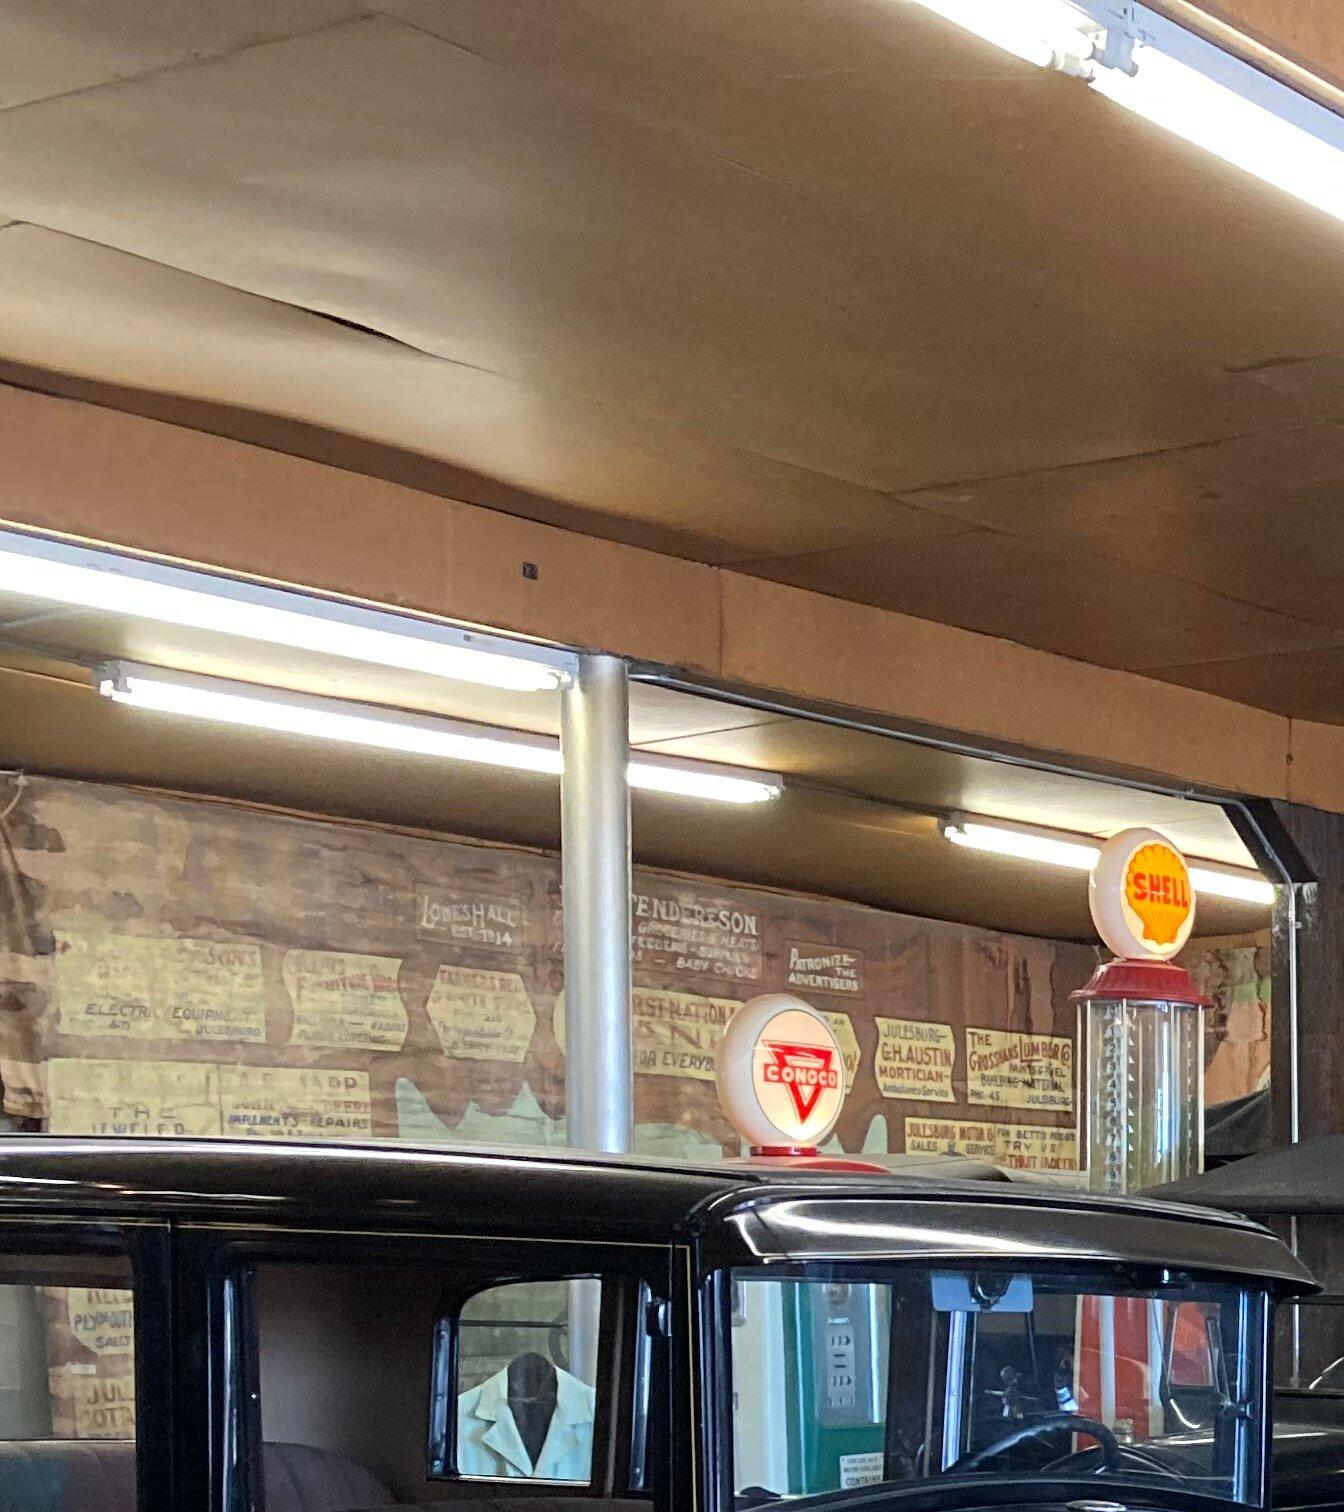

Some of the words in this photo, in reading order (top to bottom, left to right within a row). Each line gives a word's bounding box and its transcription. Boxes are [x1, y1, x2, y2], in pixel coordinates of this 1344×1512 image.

[1133, 873, 1189, 909] SHELL
[676, 956, 710, 971] BABY
[835, 966, 857, 978] THE
[969, 1031, 992, 1048] THE
[1019, 1035, 1060, 1063] LUMBER
[763, 1063, 839, 1088] CONOCO
[109, 1106, 177, 1120] THE
[910, 1140, 939, 1152] SALES
[1004, 1140, 1033, 1152] TRY
